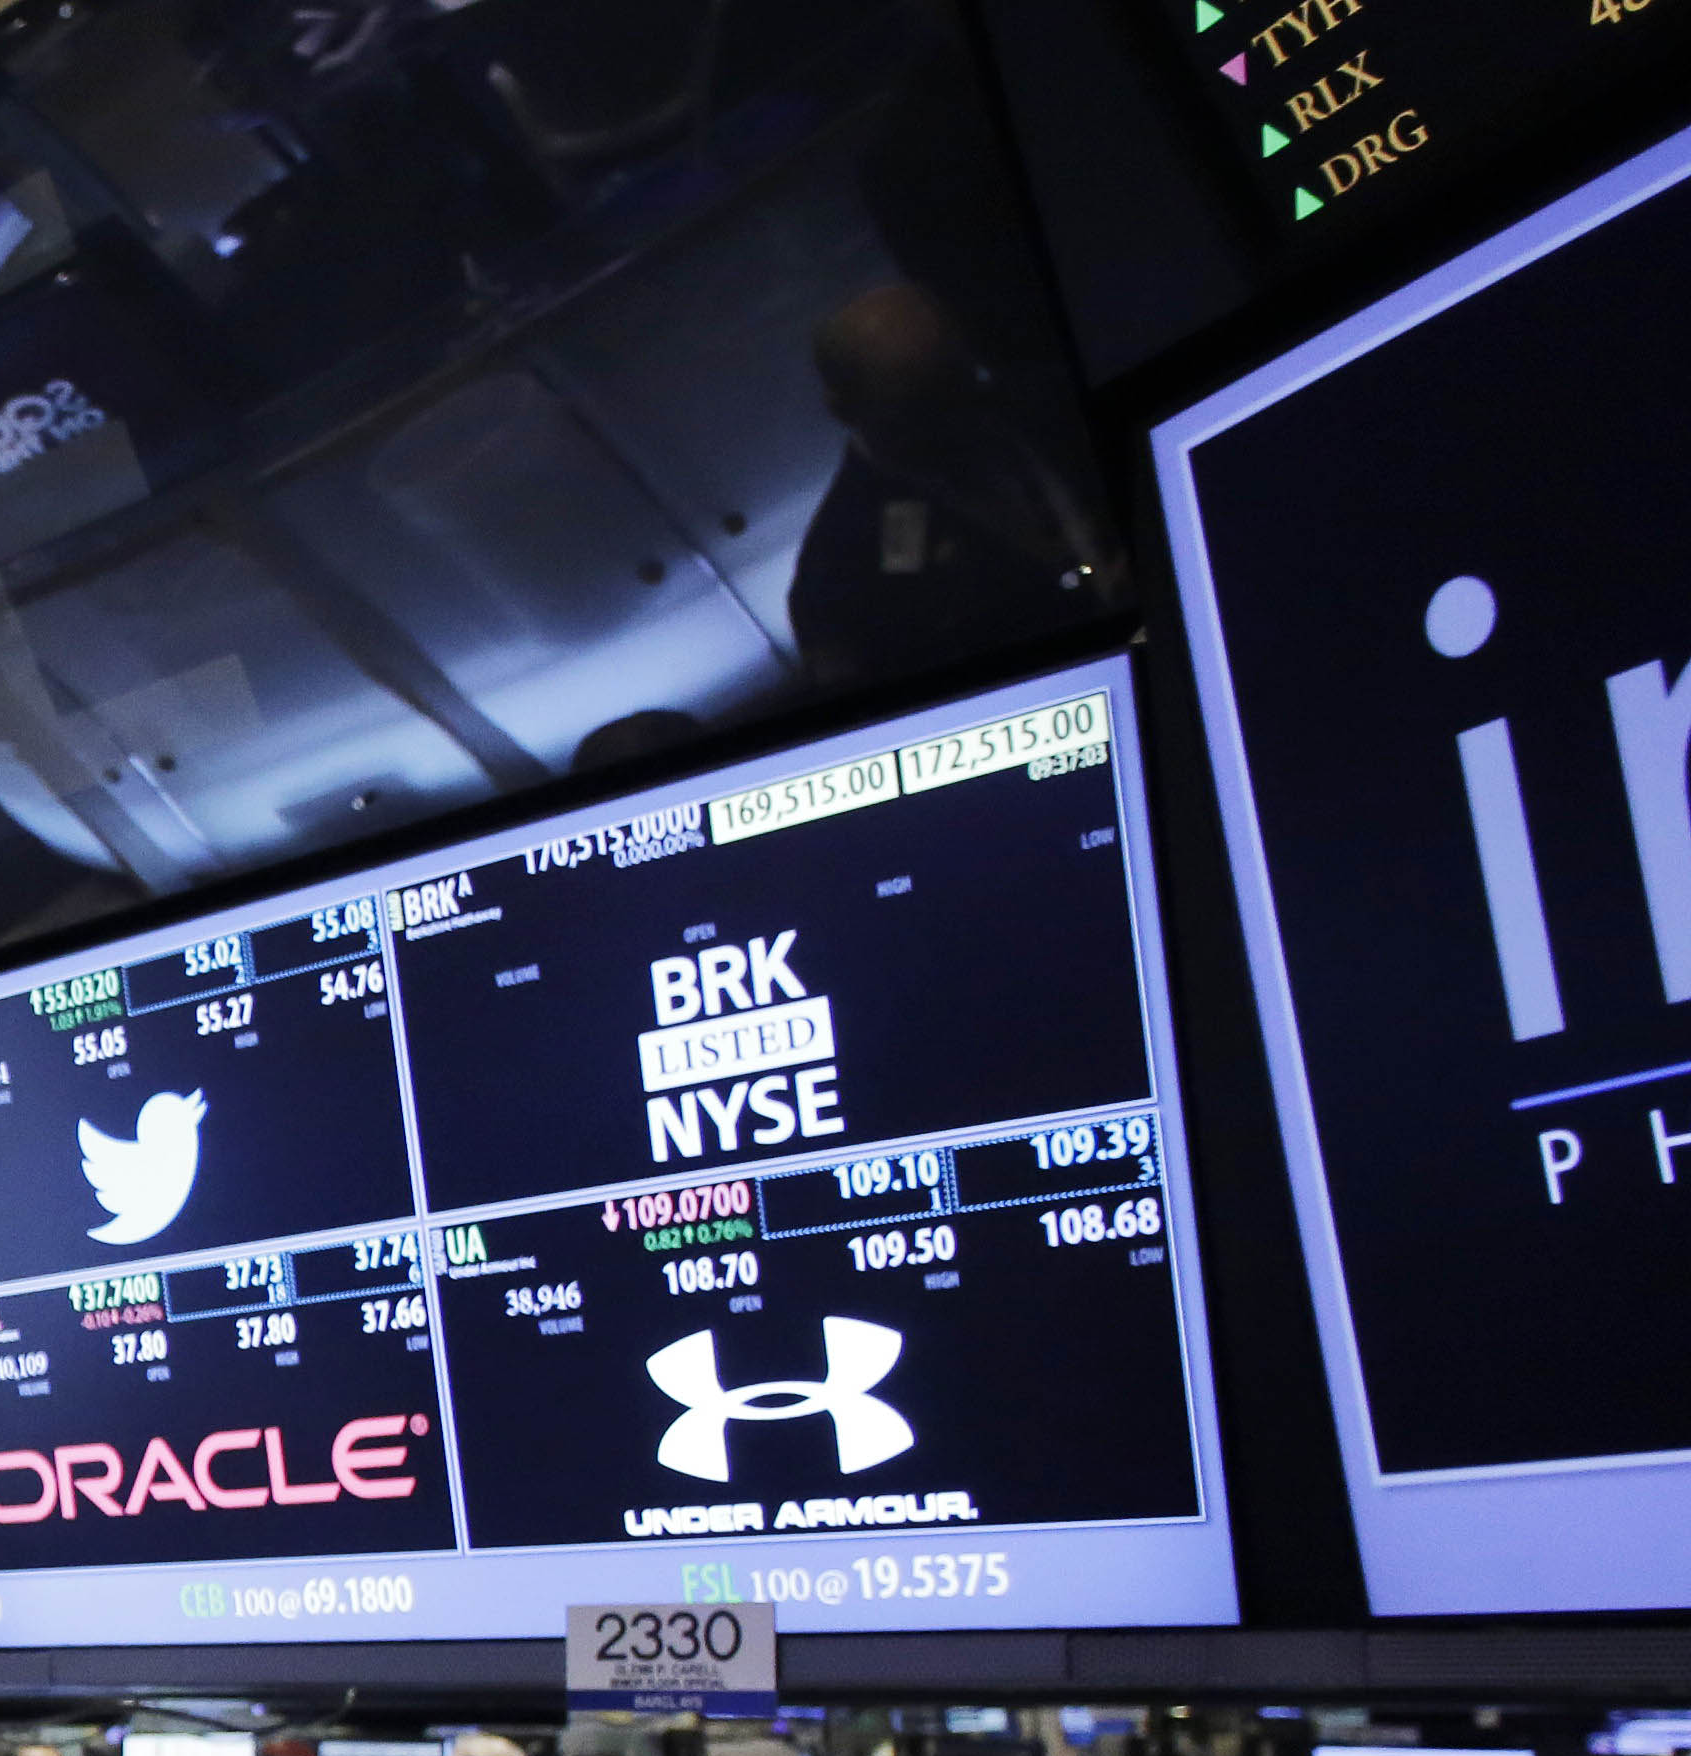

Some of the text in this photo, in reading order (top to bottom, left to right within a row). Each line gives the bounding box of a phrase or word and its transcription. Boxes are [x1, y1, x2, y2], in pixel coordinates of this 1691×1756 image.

[1284, 49, 1385, 134] RLX
[1318, 108, 1431, 197] DRG
[908, 702, 1095, 780] 172,515.00
[721, 759, 886, 831] 169,515.00
[311, 897, 376, 943] 55.08
[183, 933, 243, 977] 55.02
[649, 928, 808, 1027] BRK
[319, 959, 386, 1006] 54.76
[195, 991, 255, 1037] 55.27
[72, 1024, 128, 1066] 55.05
[655, 1015, 816, 1077] LISTED
[645, 1064, 846, 1164] NYSE
[1028, 1116, 1152, 1171] 109.39
[832, 1150, 942, 1200] 109.10
[622, 1178, 751, 1231] 109.0700
[1037, 1196, 1163, 1249] 108.68
[352, 1232, 419, 1272] 37.74
[445, 1223, 488, 1266] UA
[846, 1223, 957, 1273] 109.50
[223, 1253, 285, 1291] 37.73
[661, 1249, 760, 1297] 108.70
[234, 1311, 298, 1350] 37.80
[360, 1294, 428, 1335] 37.66
[110, 1328, 169, 1366] 37.80
[623, 1502, 765, 1538] UNDER
[179, 1581, 226, 1620] CEB
[681, 1561, 742, 1605] FSL
[594, 1609, 743, 1662] 2330
